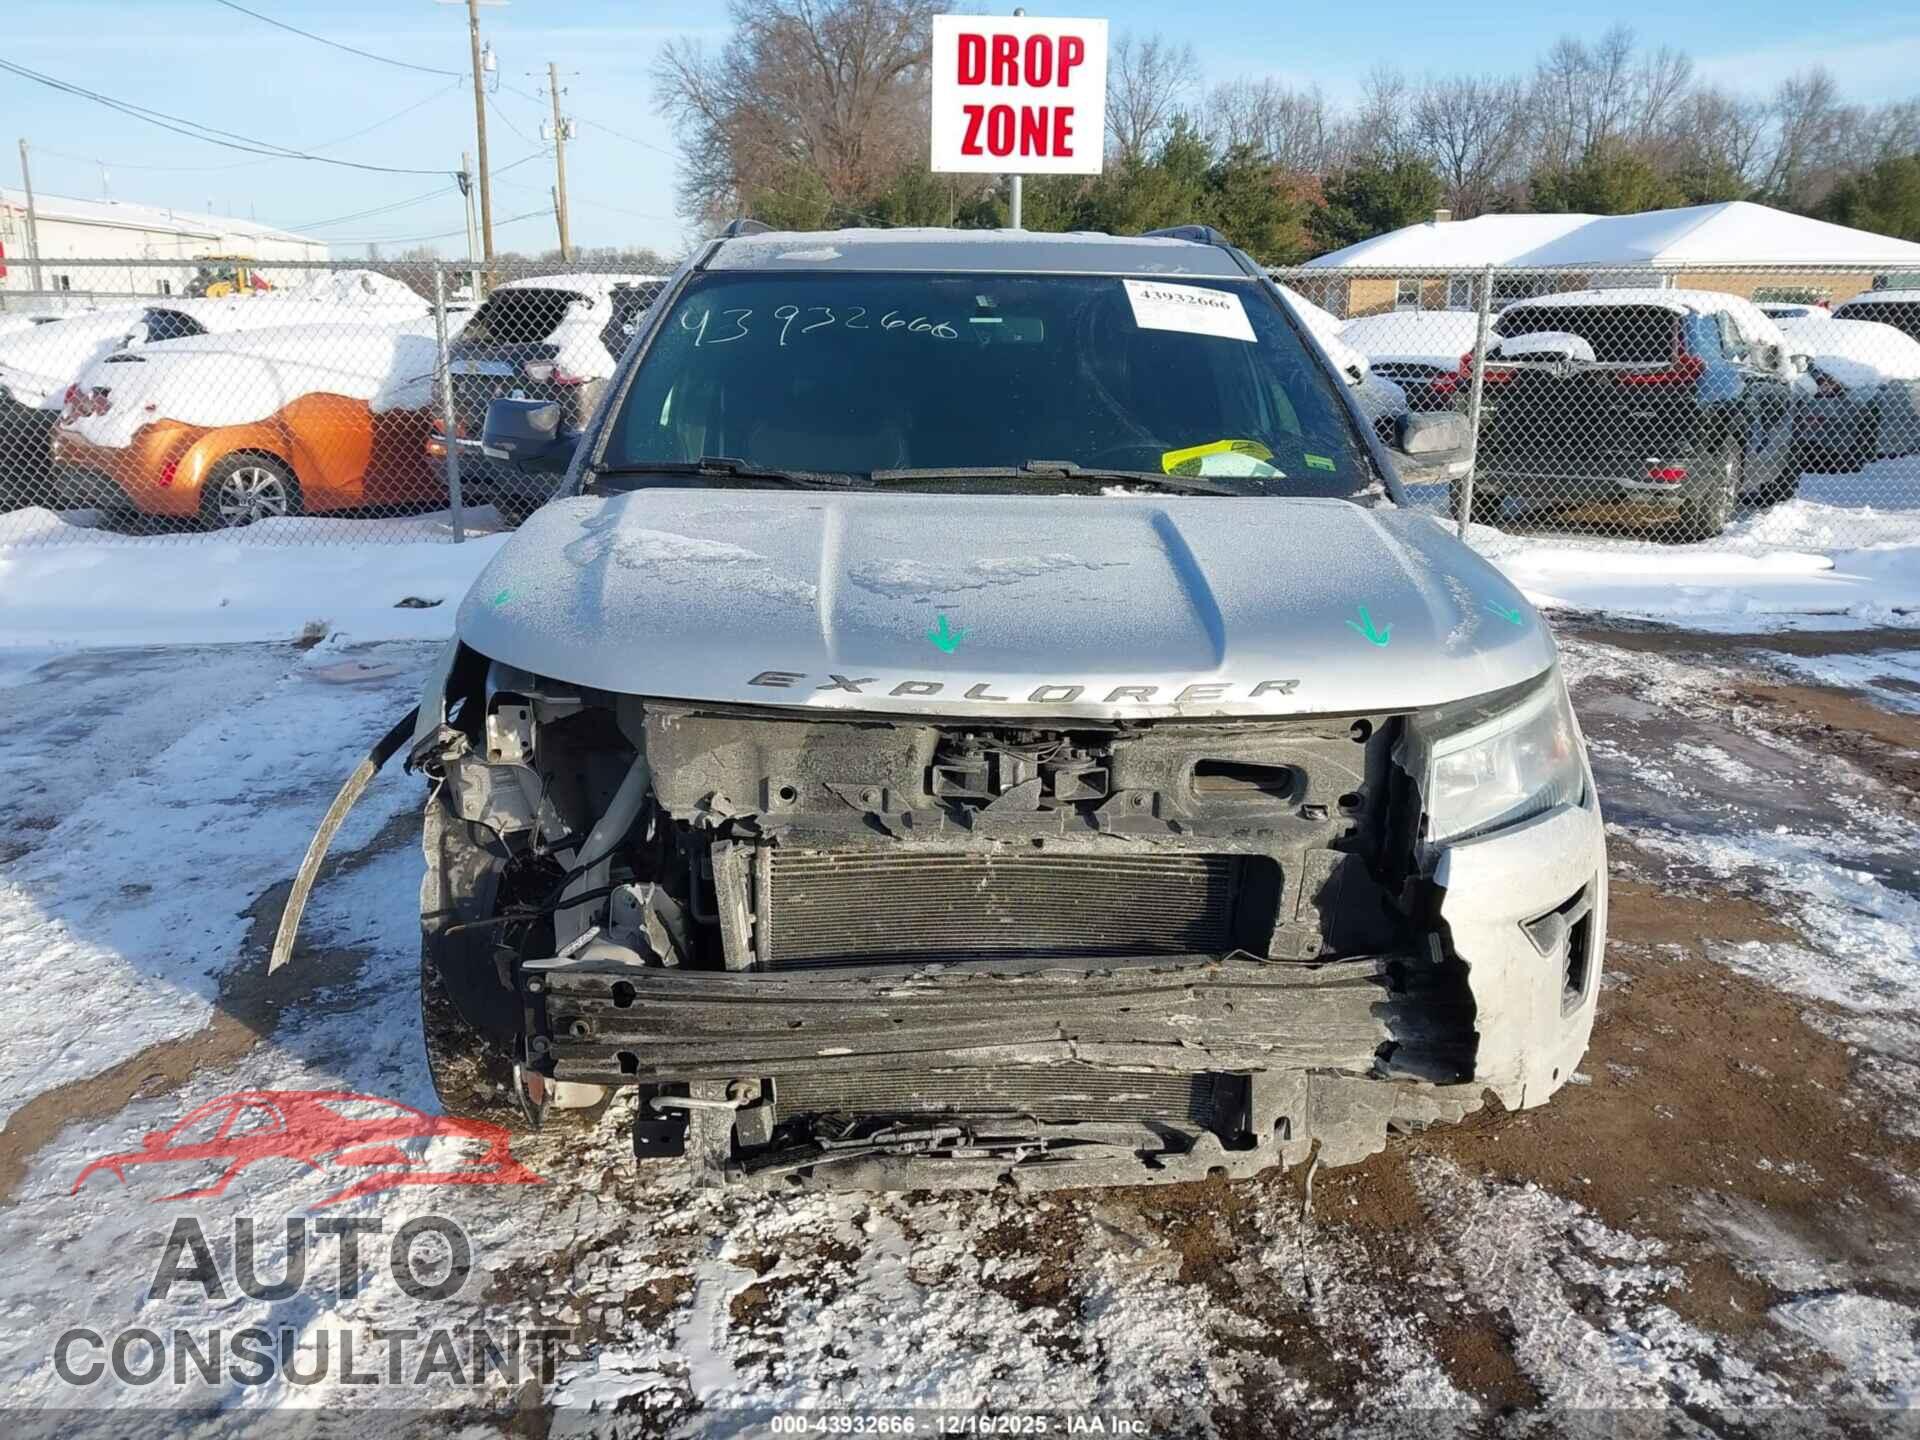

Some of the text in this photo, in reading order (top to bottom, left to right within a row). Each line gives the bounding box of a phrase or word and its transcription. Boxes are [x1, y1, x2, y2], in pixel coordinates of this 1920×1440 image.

[957, 33, 1085, 87] DROP
[961, 104, 1074, 157] ZONE
[1140, 289, 1231, 311] 43932666
[747, 670, 1301, 704] EXPLORER
